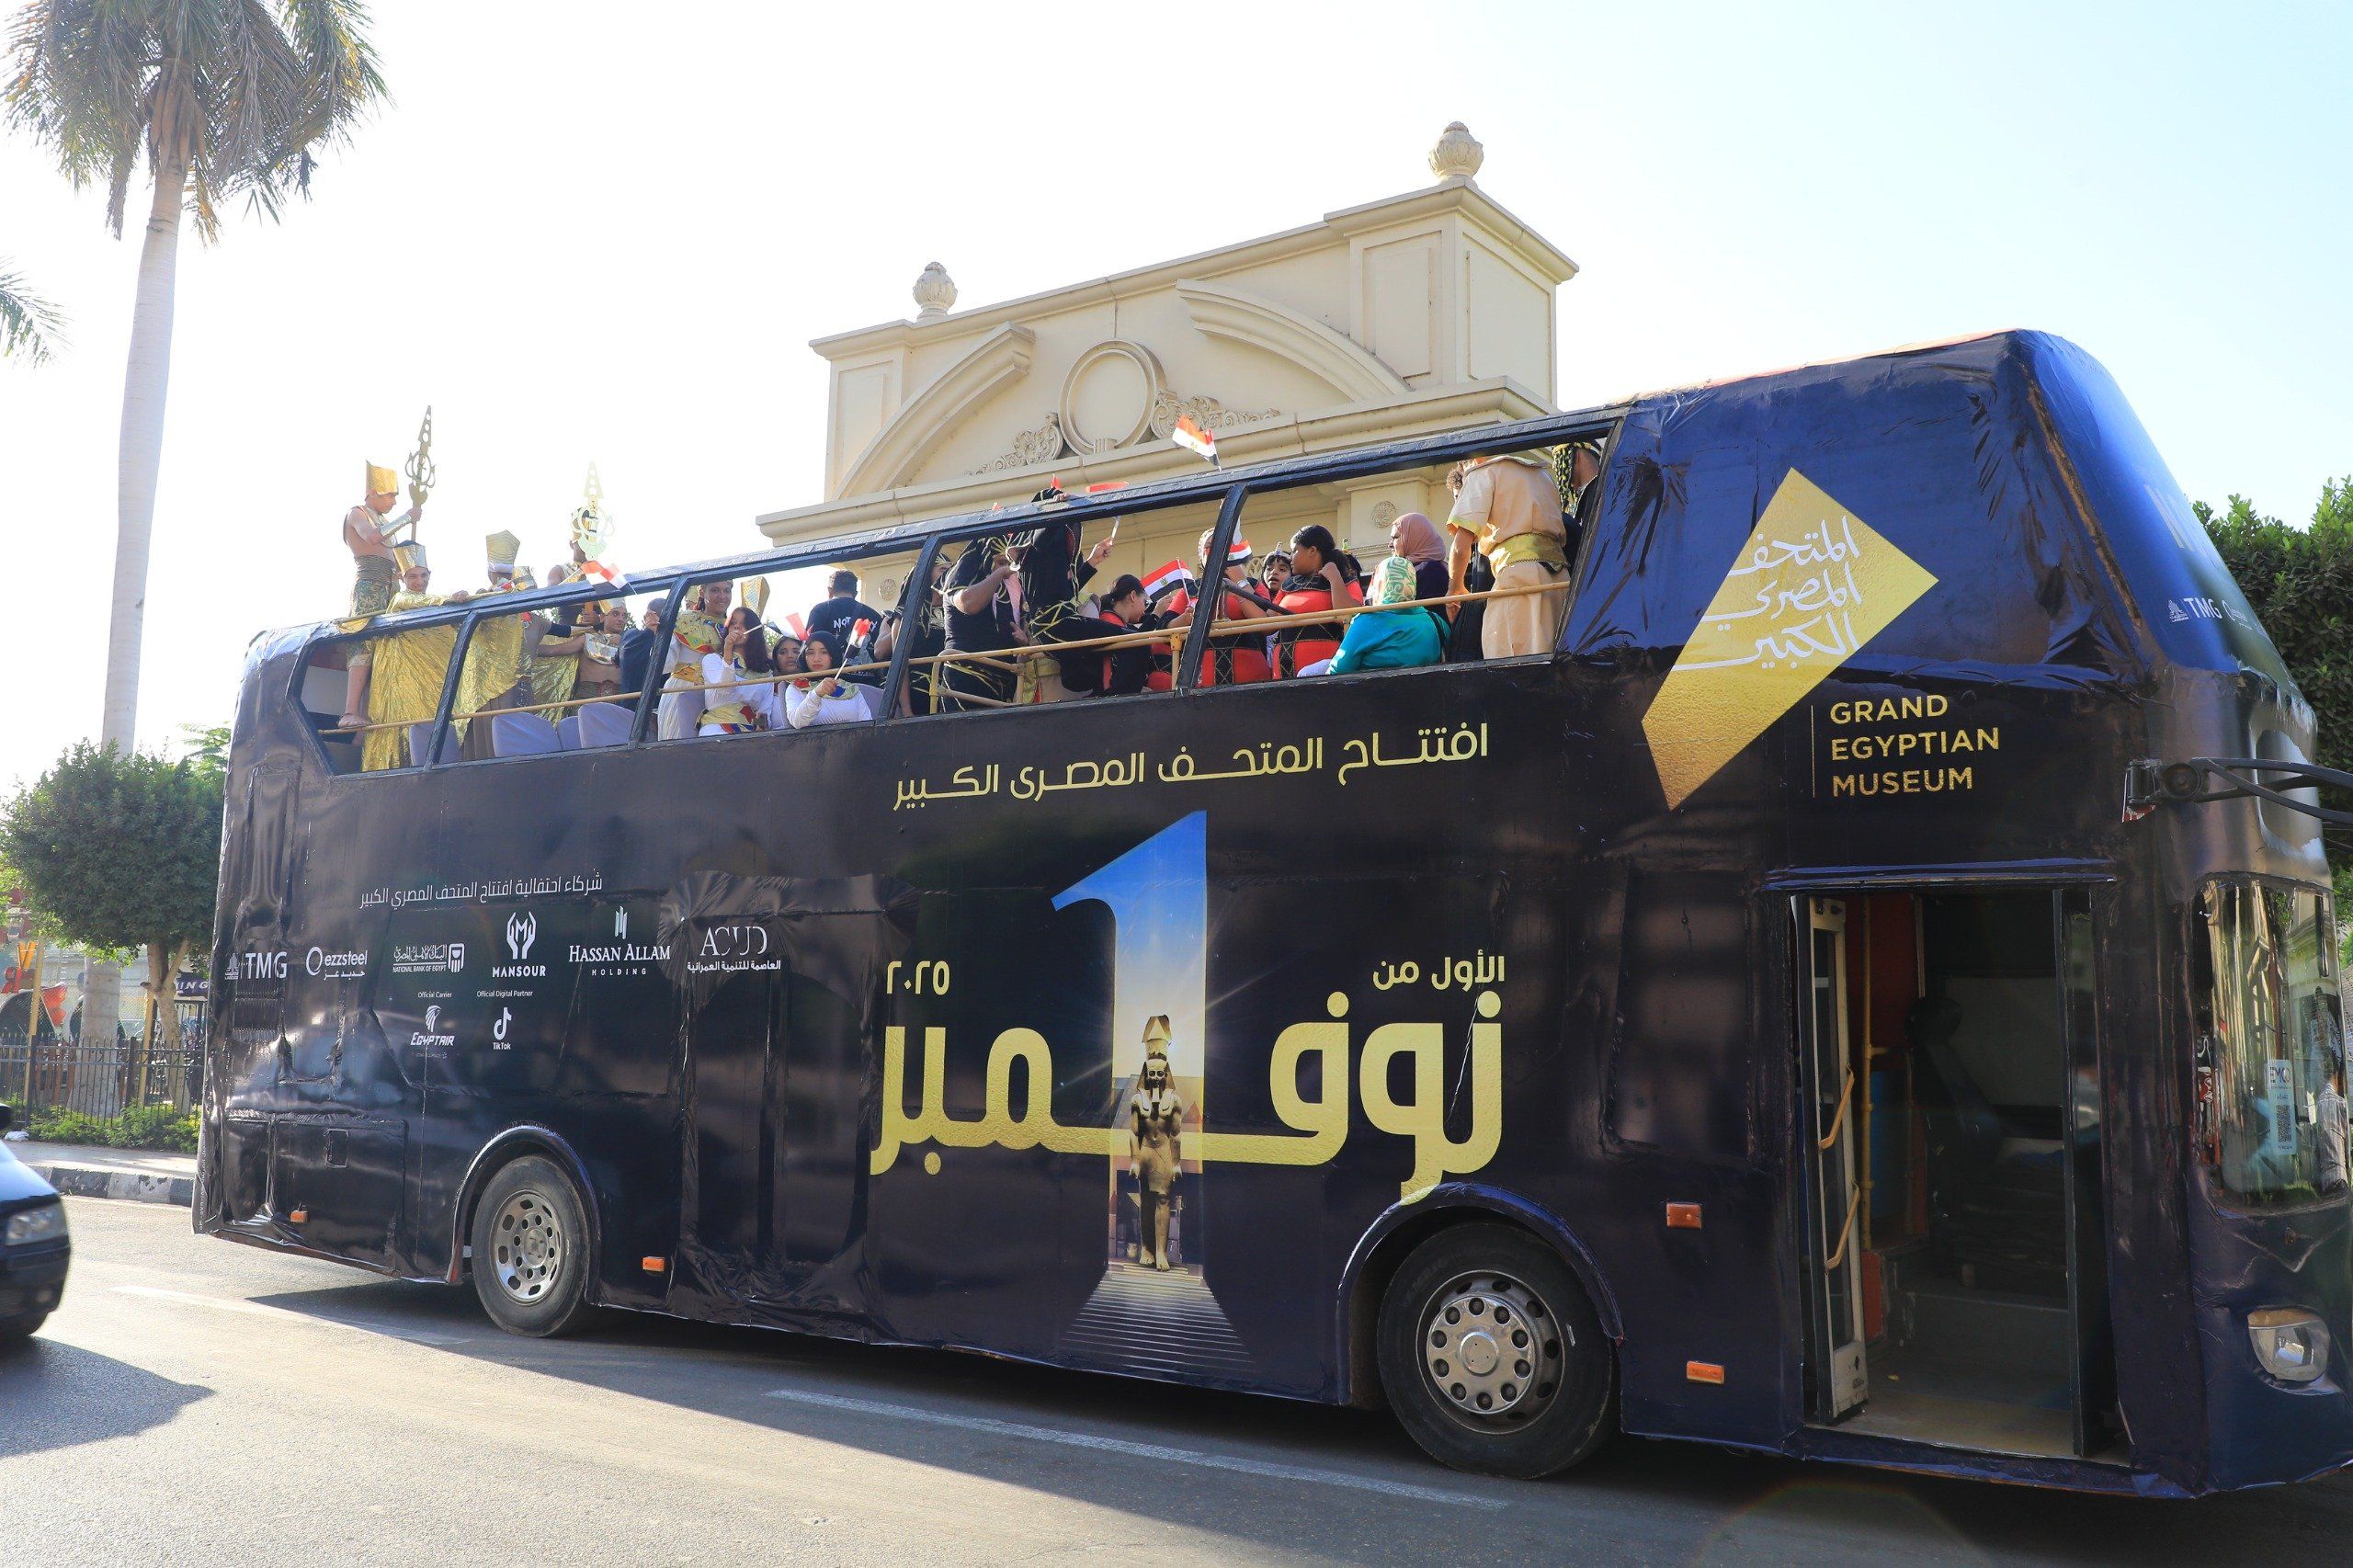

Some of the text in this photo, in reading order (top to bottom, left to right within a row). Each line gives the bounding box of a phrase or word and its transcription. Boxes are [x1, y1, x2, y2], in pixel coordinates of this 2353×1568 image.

[1727, 516, 1859, 576] المتحف
[1699, 562, 1862, 631] المصري
[2184, 597, 2222, 619] TMG
[834, 617, 851, 632] NOT
[1671, 611, 1860, 671] الكبير
[1830, 695, 1948, 725] GRAND
[1158, 738, 1324, 782] المتحف
[1338, 722, 1489, 786] افتتاح
[1831, 727, 1999, 761] EGYPTIAN
[892, 764, 998, 812] الكبير
[1832, 767, 1972, 797] MUSEUM
[359, 871, 602, 910] شركاء احتفالية افتتاح المتحف المصري الكبير
[245, 951, 287, 979] TMG
[324, 950, 368, 966] ezzsteel
[493, 966, 546, 977] MANSOUR
[688, 960, 781, 973] العاصمة للتنمية العمرانية
[1371, 949, 1506, 994] الأول من
[886, 959, 950, 996] ٢٠٢٥
[870, 991, 1503, 1206] نوفمبر
